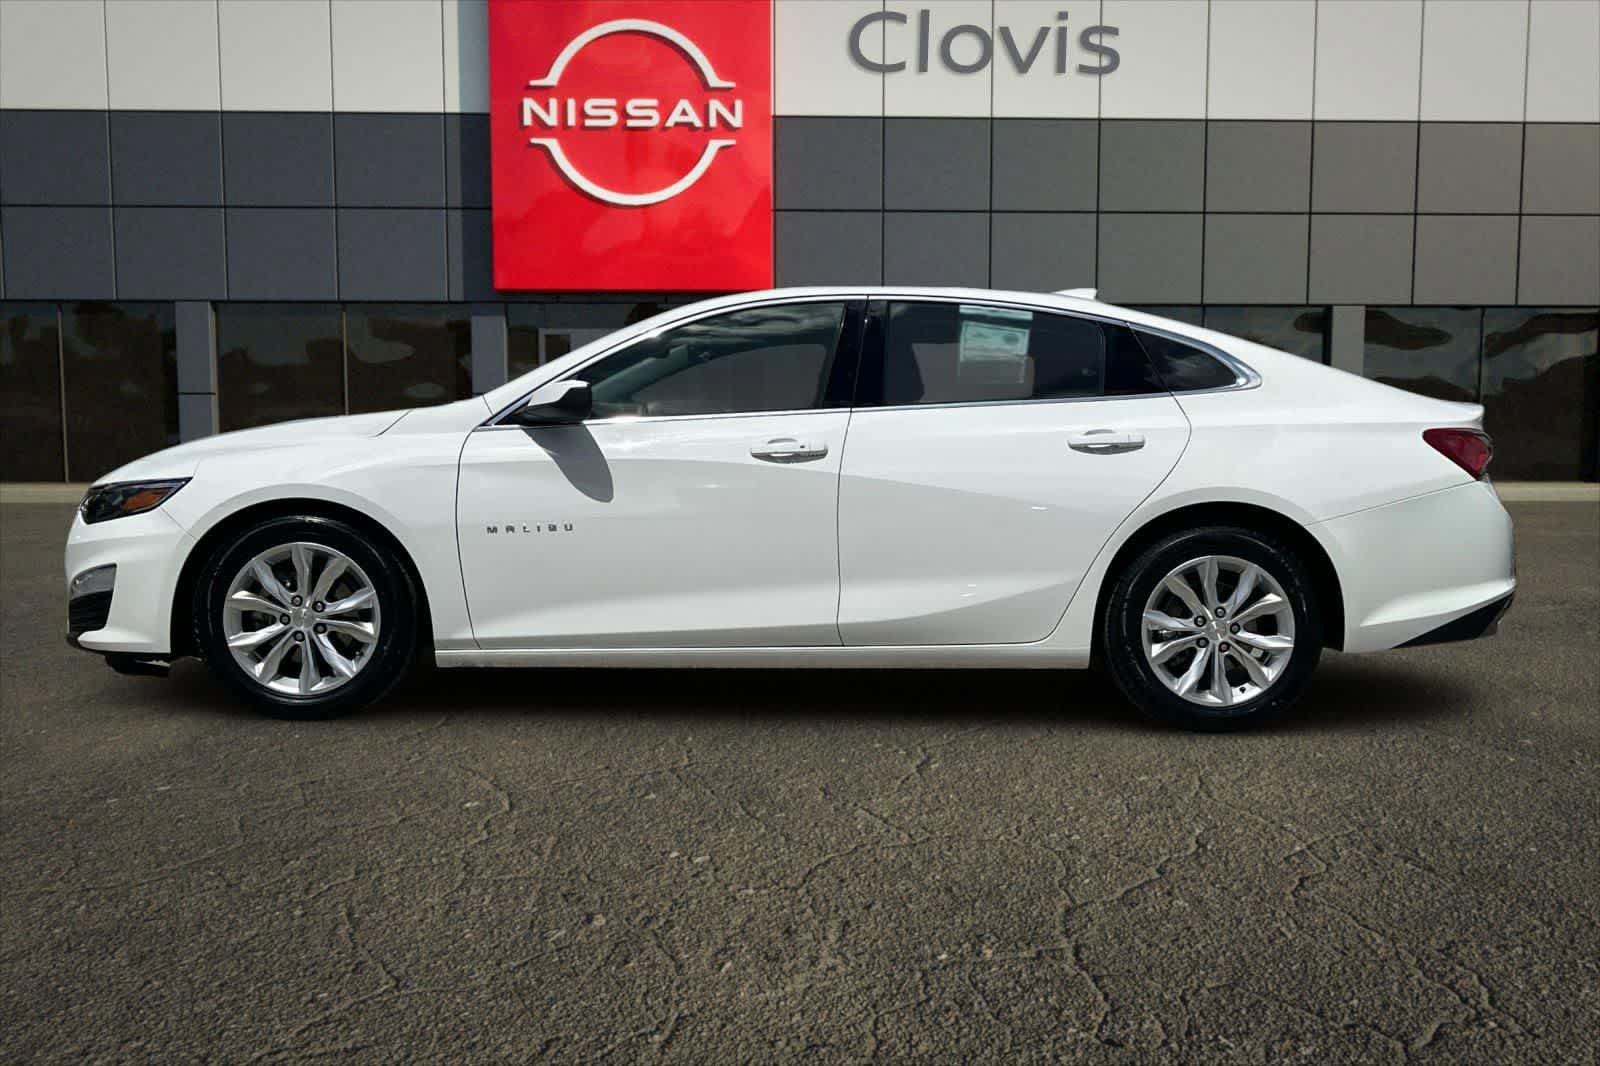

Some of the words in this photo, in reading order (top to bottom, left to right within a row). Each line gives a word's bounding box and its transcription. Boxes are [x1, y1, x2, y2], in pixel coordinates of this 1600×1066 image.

[849, 9, 1121, 75] Clovis
[522, 97, 744, 129] NISSAN
[486, 523, 574, 535] MALIBU
